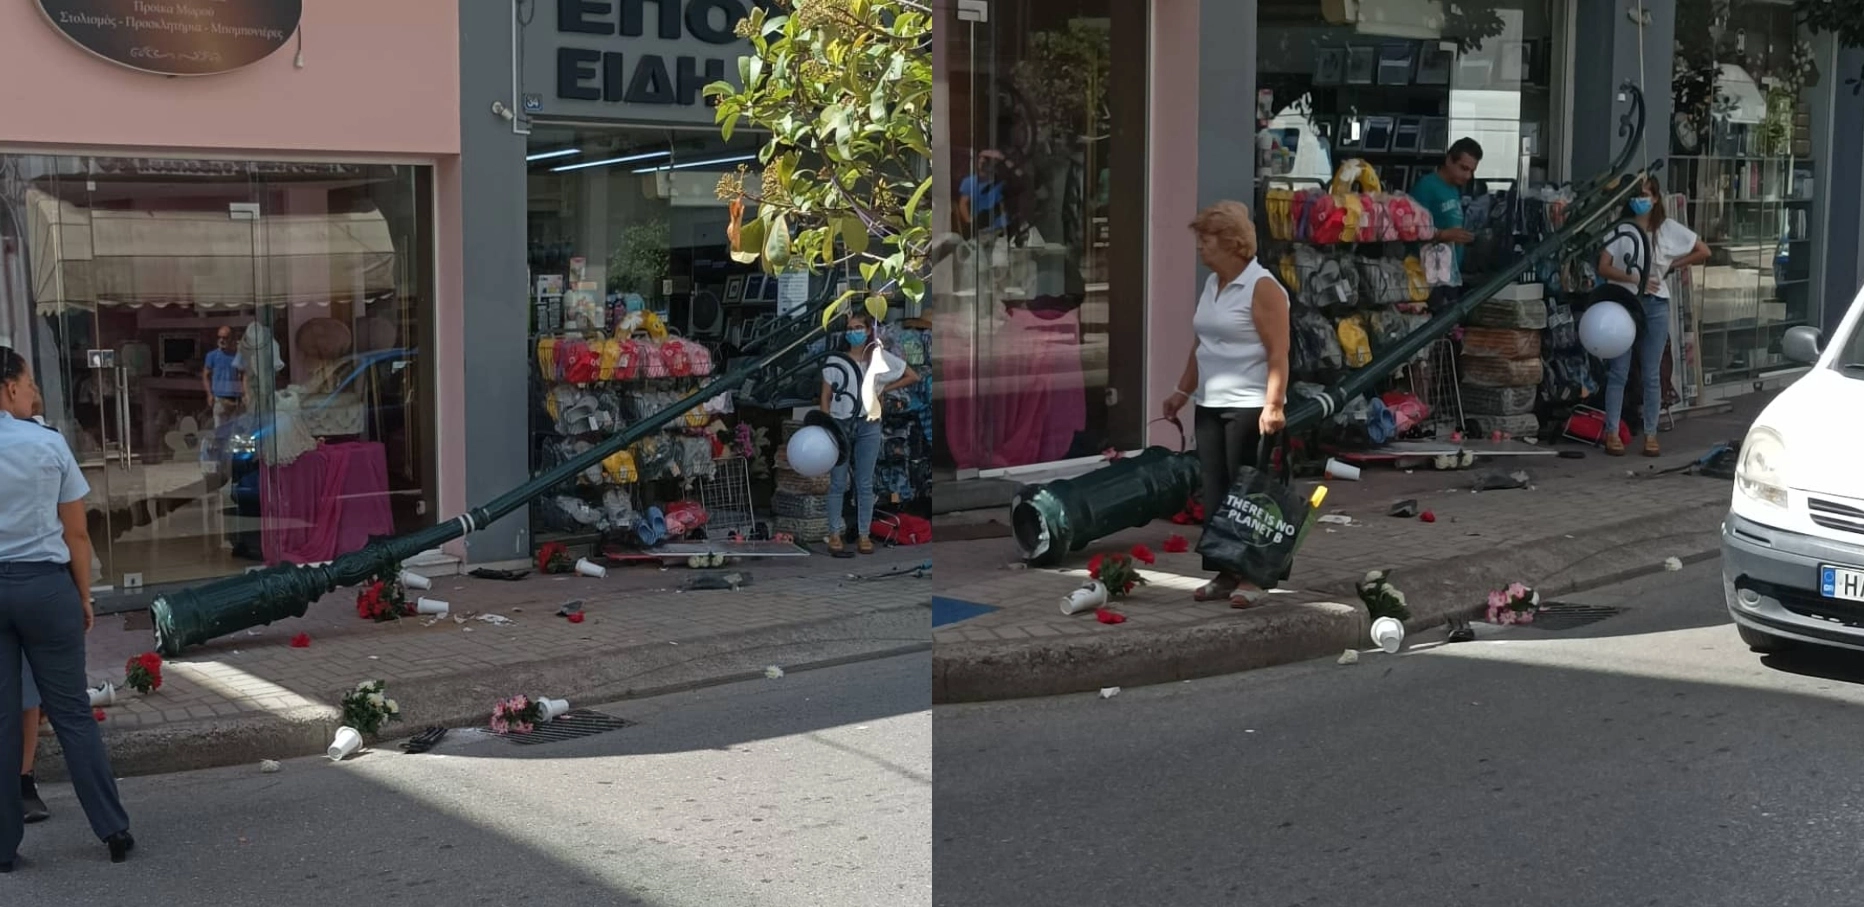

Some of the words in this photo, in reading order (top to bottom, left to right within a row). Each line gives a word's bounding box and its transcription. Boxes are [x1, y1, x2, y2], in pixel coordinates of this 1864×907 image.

[60, 11, 117, 29] Στολισμός
[557, 0, 785, 45] ΕΠΟ
[557, 47, 725, 107] ΕΙΔΗ
[1226, 495, 1264, 519] THERE
[1264, 512, 1275, 525] IS
[1276, 520, 1295, 536] NO
[1228, 510, 1273, 537] PLANET
[1273, 532, 1284, 544] B
